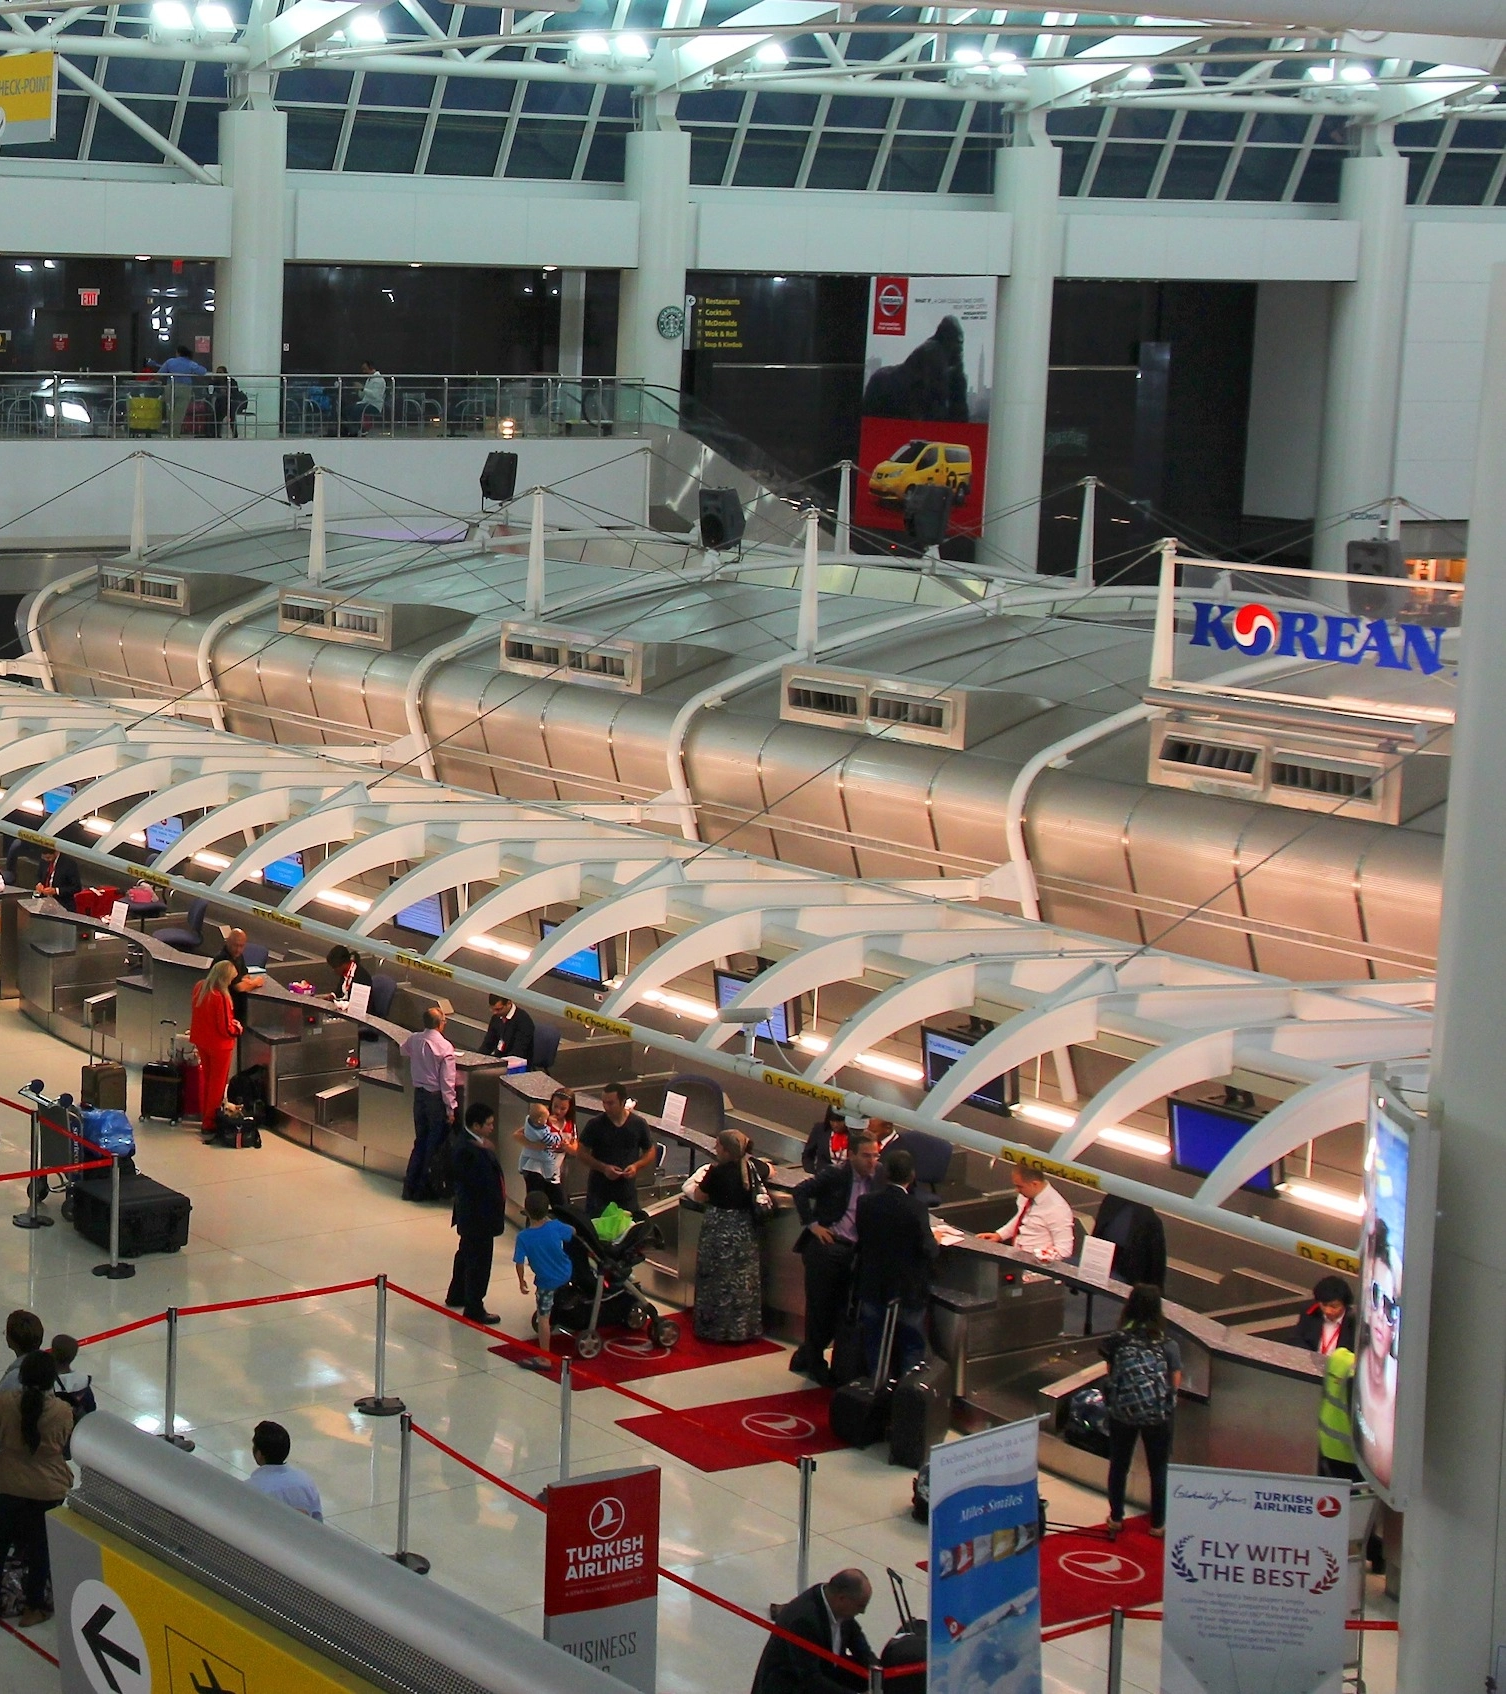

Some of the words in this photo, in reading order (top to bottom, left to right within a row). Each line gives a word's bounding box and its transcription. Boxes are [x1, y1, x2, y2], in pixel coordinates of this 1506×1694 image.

[82, 292, 98, 306] EXIT
[705, 298, 741, 306] Restaurants
[1189, 602, 1447, 676] KOREAN
[778, 1078, 785, 1089] 5
[788, 1082, 831, 1103] Check-in
[1254, 1491, 1314, 1505] TURKISH
[1254, 1501, 1314, 1515] AIRLINES
[566, 1535, 644, 1563] TURKISH
[1201, 1540, 1240, 1559] FLY
[1247, 1544, 1310, 1566] WITH
[565, 1552, 644, 1581] AIRLINES
[1198, 1562, 1245, 1583] THE
[1253, 1568, 1311, 1588] BEST
